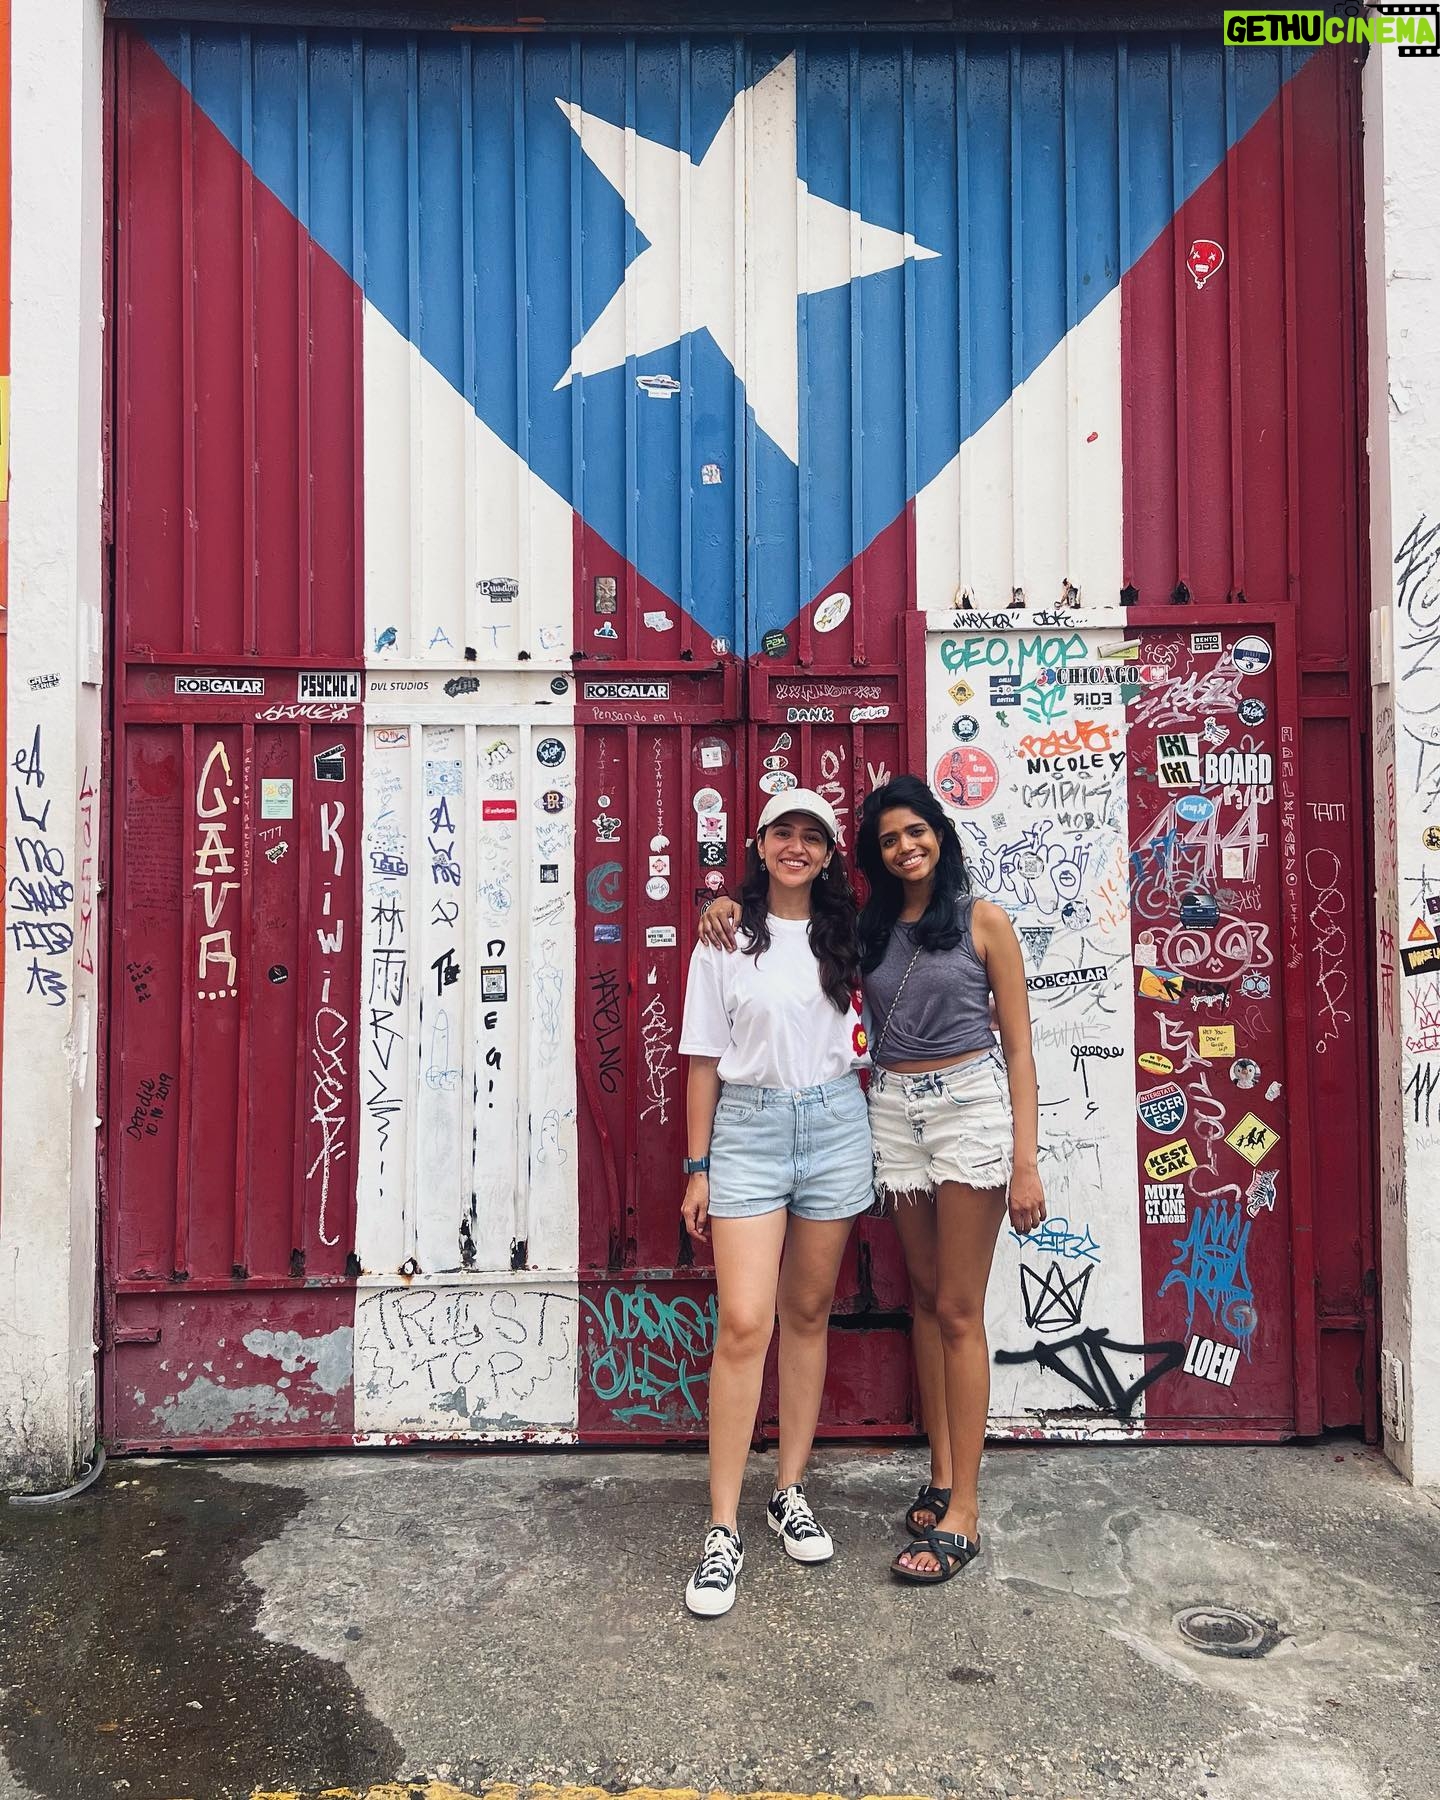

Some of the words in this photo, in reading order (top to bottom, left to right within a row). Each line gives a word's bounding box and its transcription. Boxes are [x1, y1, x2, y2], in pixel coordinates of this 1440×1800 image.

[1056, 666, 1139, 684] CHICAGO
[390, 681, 429, 691] STUDIOS
[592, 707, 647, 722] Pensando
[653, 713, 666, 722] en
[1158, 734, 1198, 757] IXL
[1027, 753, 1104, 775] NICOLE
[1160, 761, 1201, 784] IXL
[1205, 753, 1272, 785] BOARD
[1140, 1085, 1176, 1103] INTERSTATE
[1142, 1096, 1184, 1119] ZECER
[1153, 1110, 1181, 1128] ESA
[1149, 1144, 1189, 1169] KEST
[1155, 1156, 1190, 1177] GAK
[1144, 1184, 1185, 1200] MUTZ
[1182, 1335, 1241, 1386] LOEH
